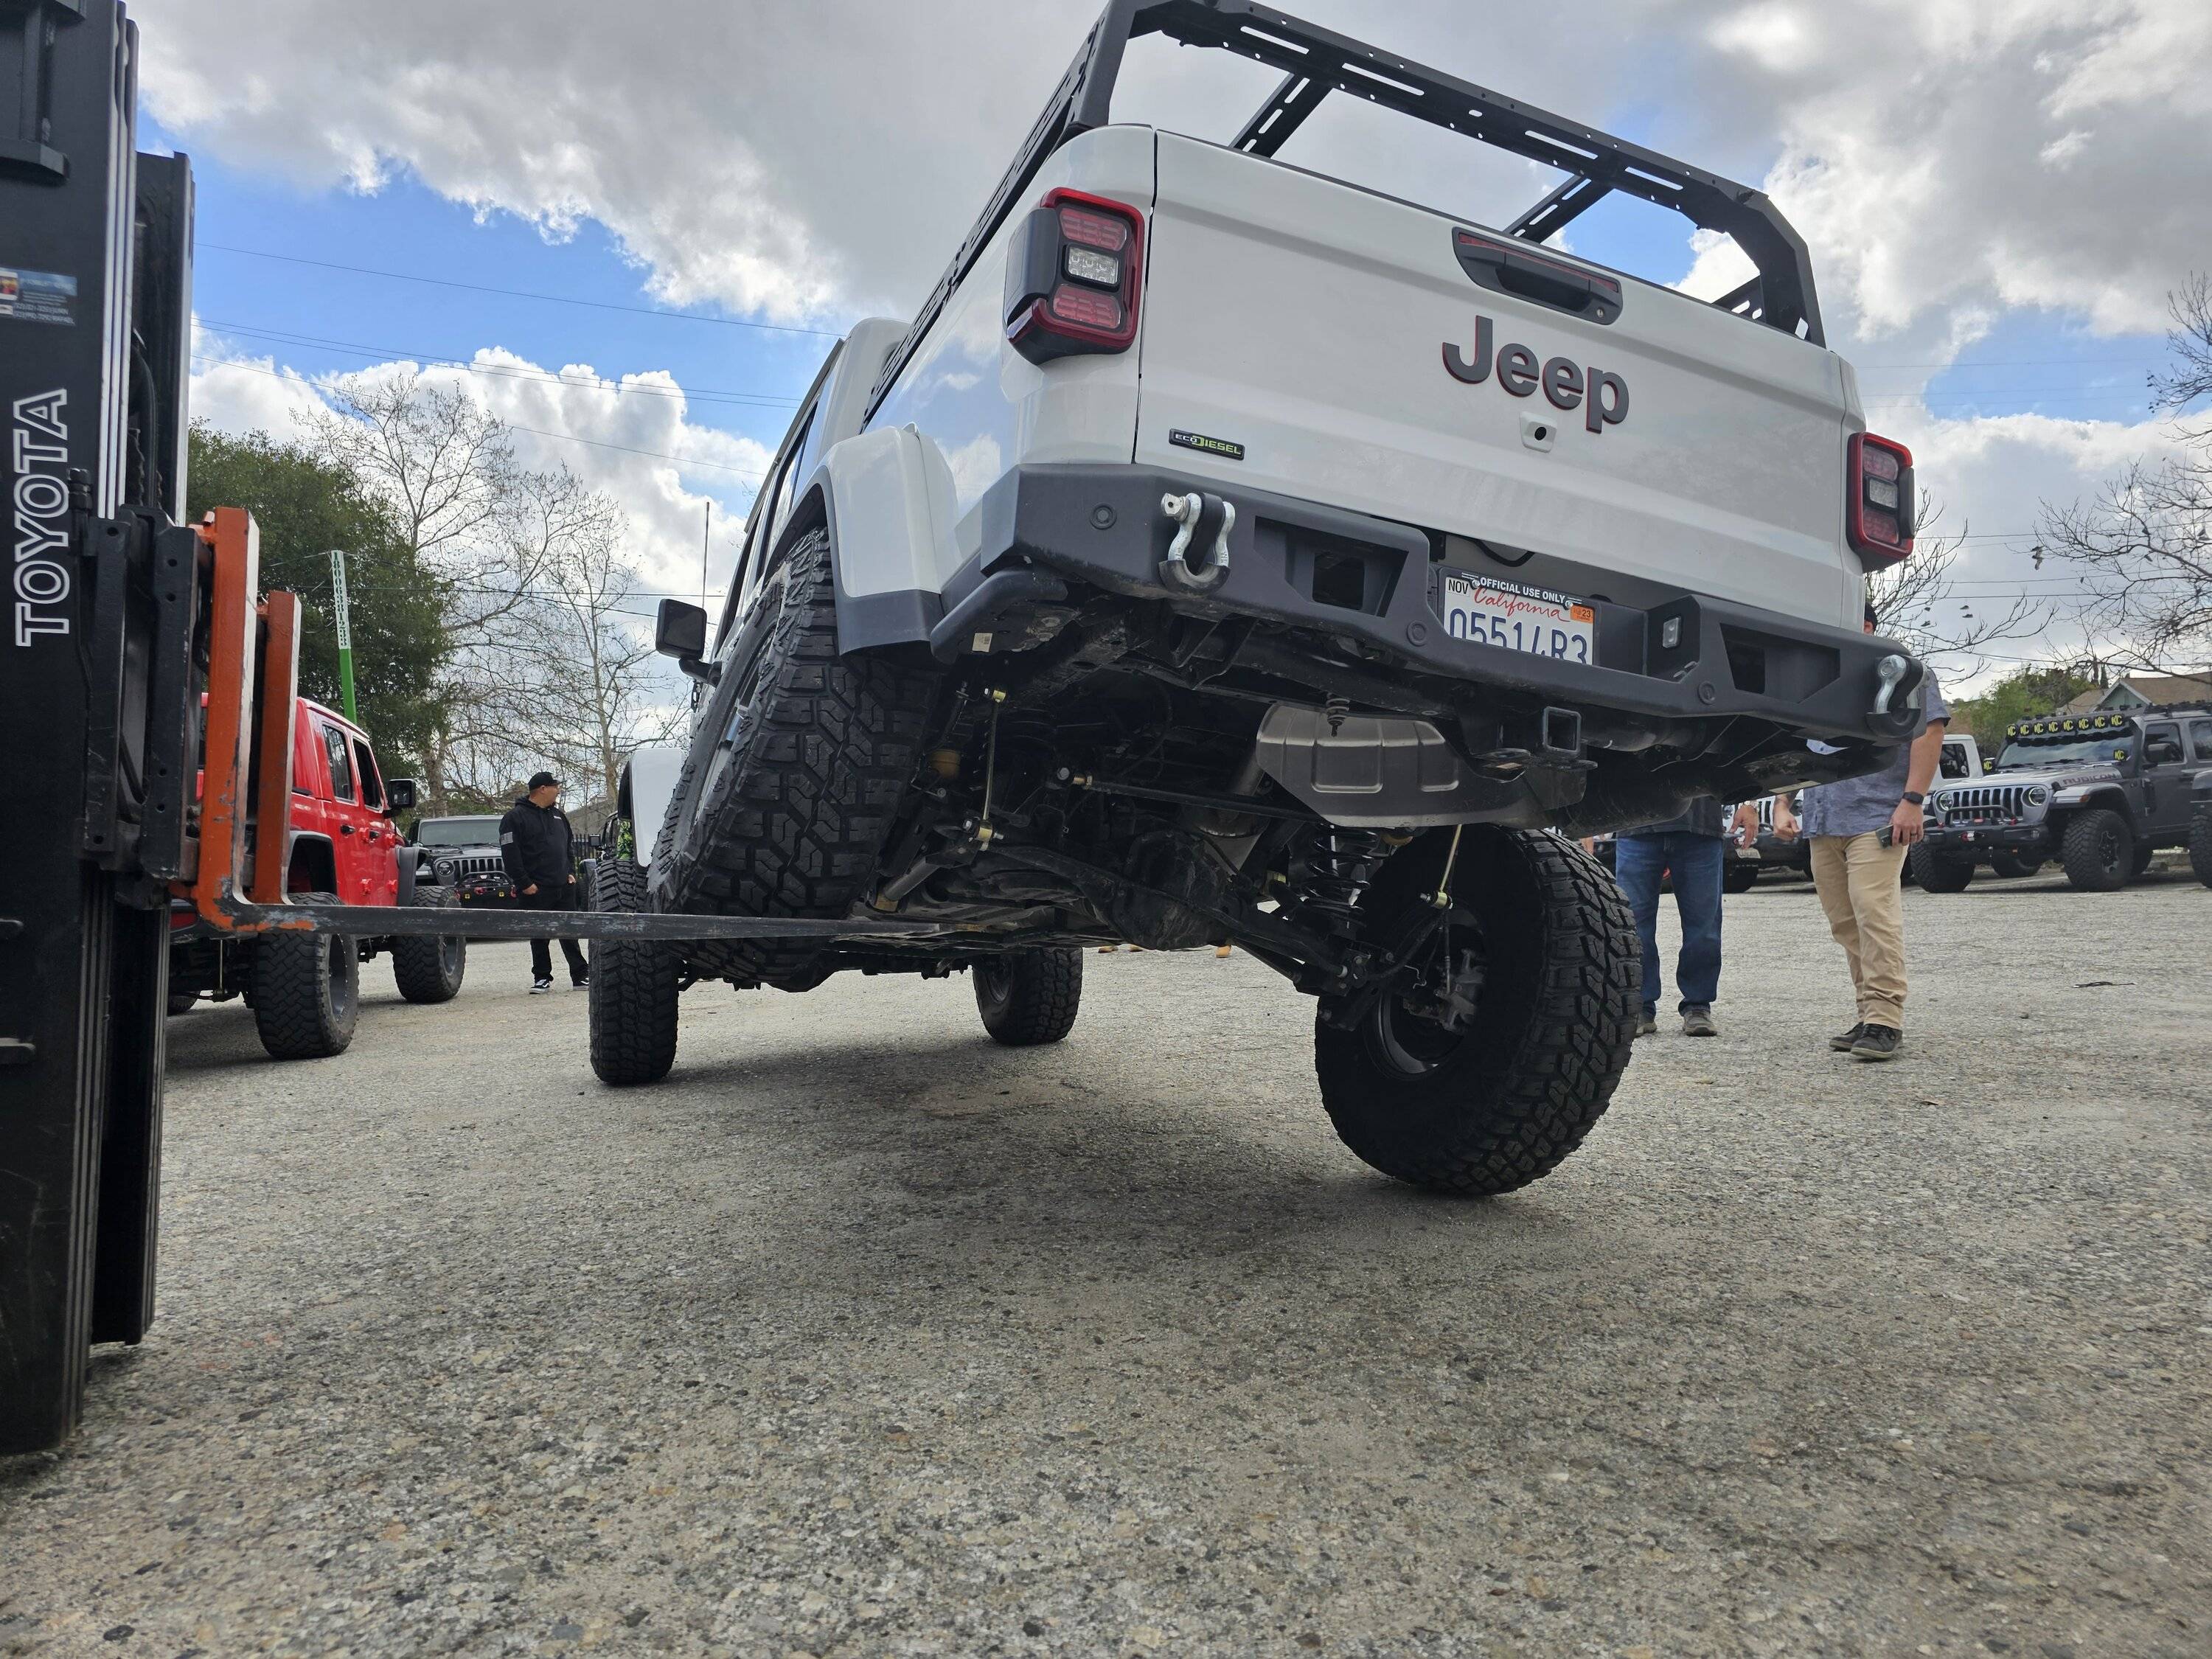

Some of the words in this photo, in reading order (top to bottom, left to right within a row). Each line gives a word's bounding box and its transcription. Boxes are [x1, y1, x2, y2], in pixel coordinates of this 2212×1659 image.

[1442, 315, 1630, 434] Jeep
[13, 389, 70, 647] TOYOTA
[1448, 579, 1469, 594] NOV
[1480, 577, 1520, 594] OFFICIAL
[1523, 586, 1540, 599] USE
[1543, 591, 1565, 604] ONLY
[1474, 585, 1571, 622] California
[2007, 726, 2017, 737] KC
[2020, 725, 2029, 735] KC
[2034, 723, 2044, 734] KC
[2048, 721, 2059, 732] KC
[2063, 720, 2073, 731] KC
[2079, 718, 2089, 729] KC
[2094, 716, 2105, 728] KC
[2111, 714, 2123, 726] KC
[2114, 749, 2124, 760] KC
